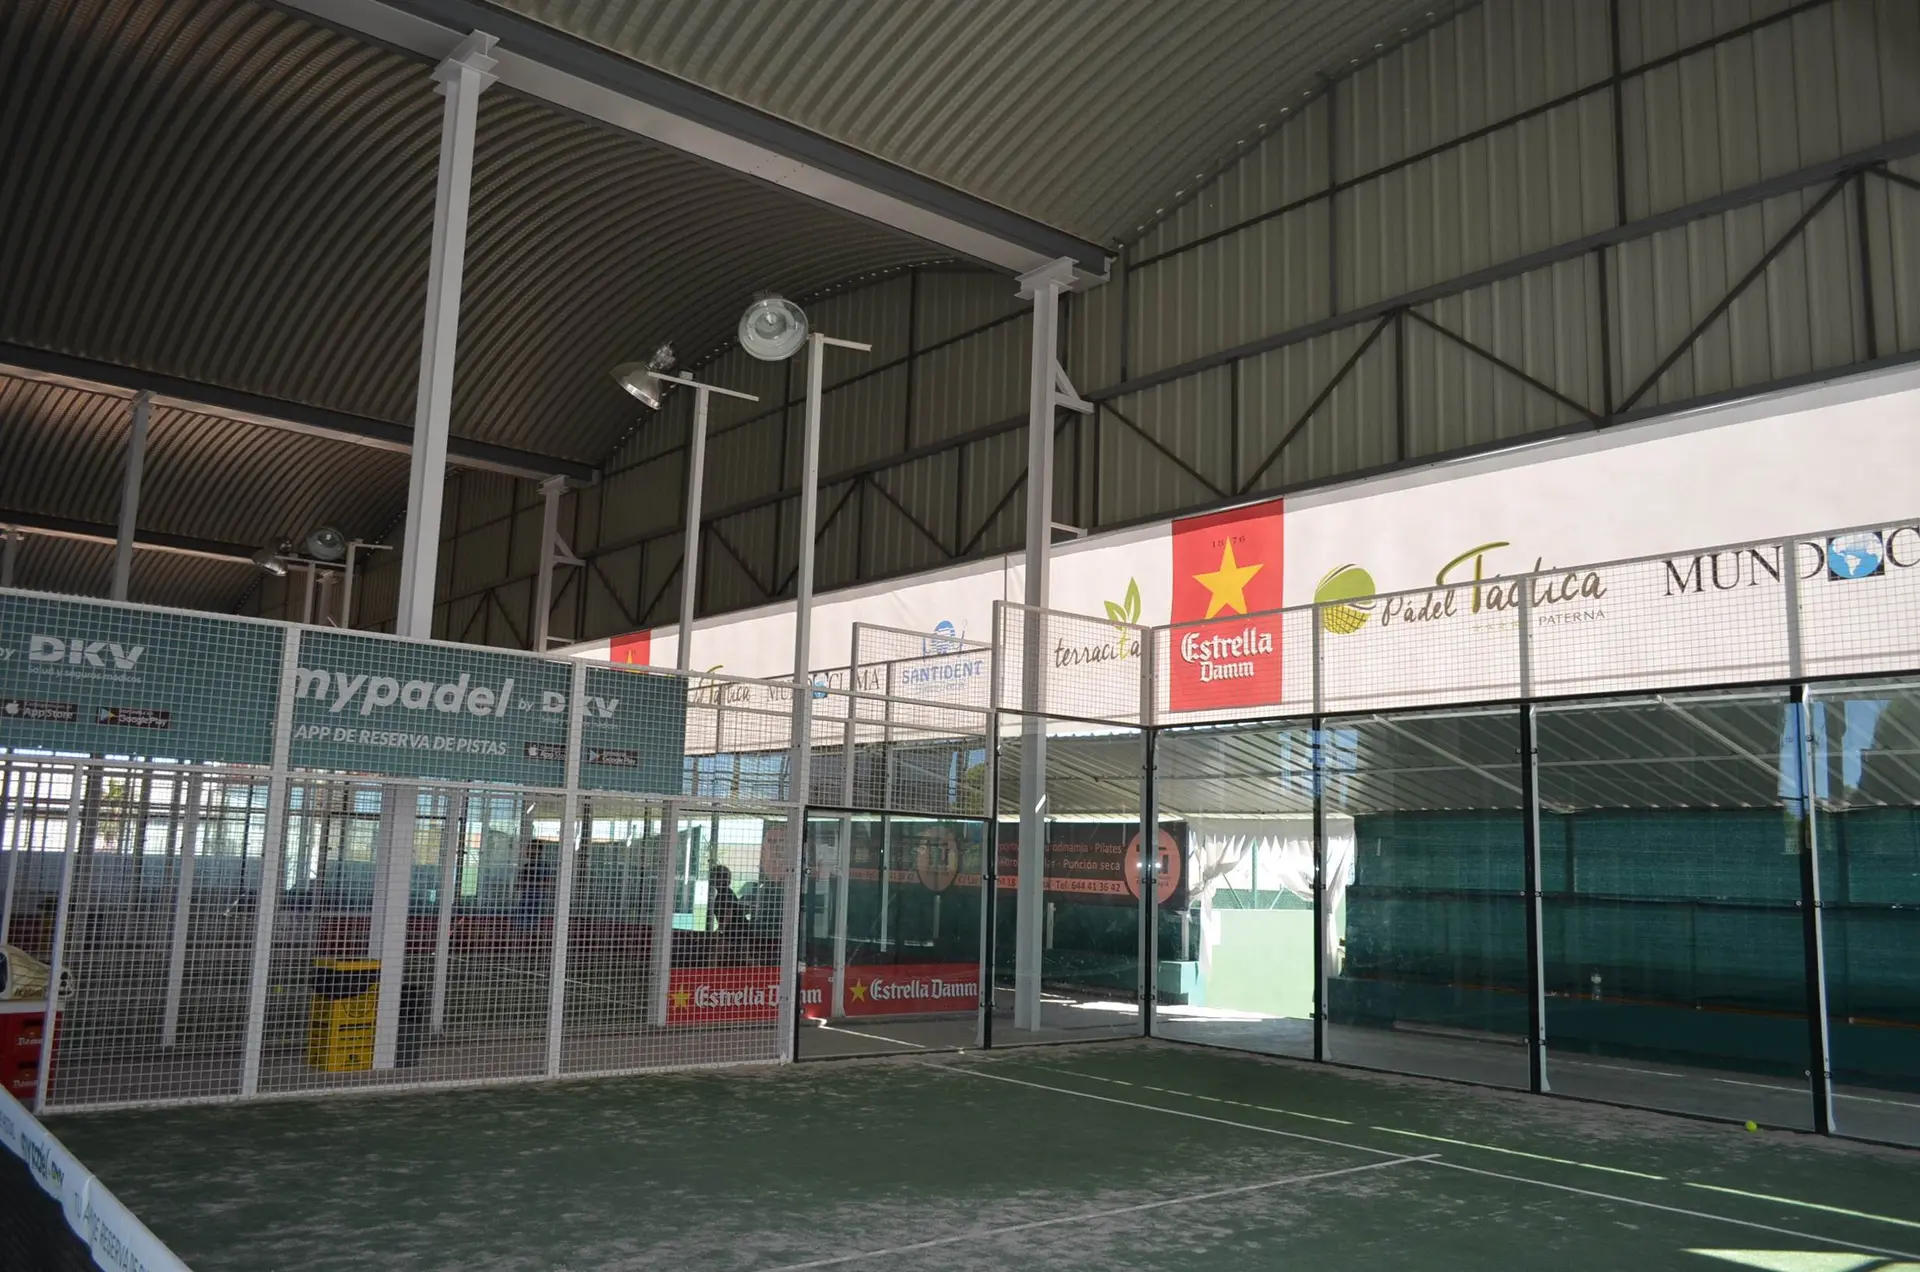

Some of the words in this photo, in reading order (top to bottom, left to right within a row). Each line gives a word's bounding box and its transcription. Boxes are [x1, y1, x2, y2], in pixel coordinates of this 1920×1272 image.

[1538, 608, 1606, 626] PATERNA
[28, 635, 145, 669] DKV
[1180, 627, 1273, 663] Estrella
[902, 660, 984, 685] SANTIDENT
[1199, 660, 1254, 683] Damm
[296, 667, 514, 717] mypadel
[518, 698, 534, 712] by
[542, 690, 619, 718] DKV
[294, 724, 330, 740] APP
[333, 727, 357, 743] DE
[359, 729, 430, 750] RESERVA
[431, 736, 456, 750] DE
[453, 738, 508, 756] PISTAS
[1094, 844, 1122, 854] Pilates
[1063, 858, 1099, 870] Punción
[1100, 862, 1121, 871] seca
[1071, 881, 1086, 890] 644
[1087, 882, 1097, 892] 41
[1110, 884, 1121, 893] 42
[694, 985, 764, 1007] Estrella
[870, 979, 929, 1000] Estrella
[931, 979, 978, 998] Damm
